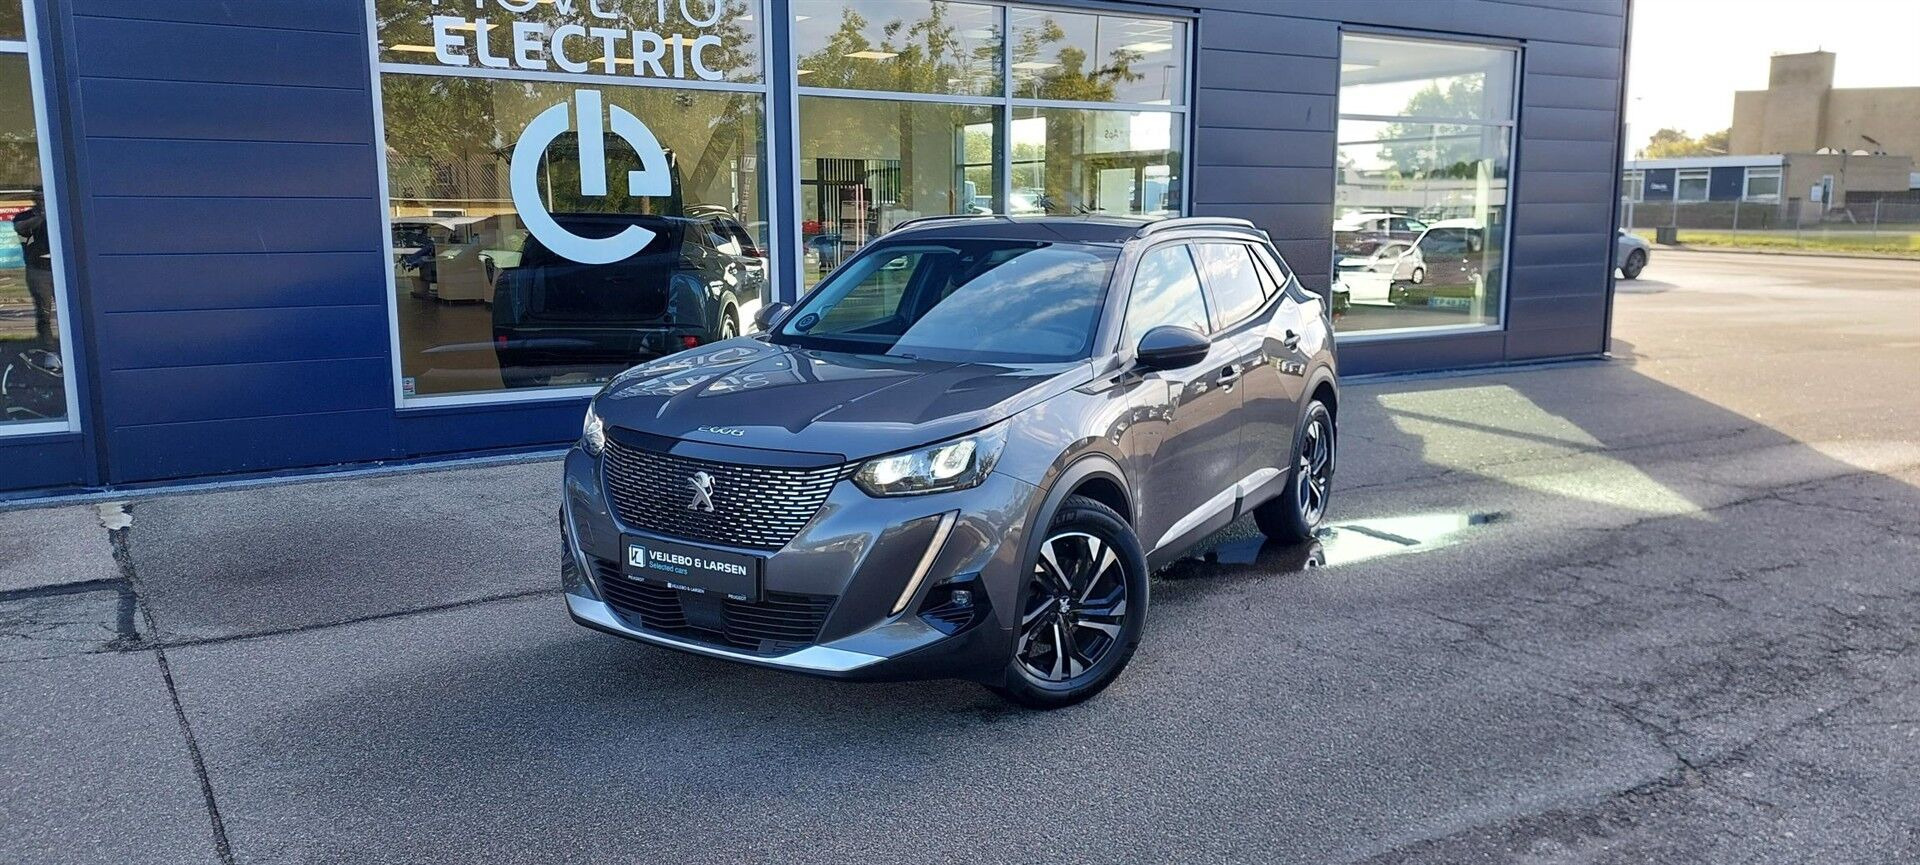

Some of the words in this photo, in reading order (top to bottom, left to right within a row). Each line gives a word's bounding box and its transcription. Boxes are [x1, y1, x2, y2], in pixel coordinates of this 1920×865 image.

[432, 15, 723, 82] ELECTRIC
[649, 550, 693, 567] VEJLEBO
[694, 558, 702, 569] &
[703, 559, 747, 576] LARSEN
[649, 561, 674, 572] Selected
[674, 567, 689, 576] cars
